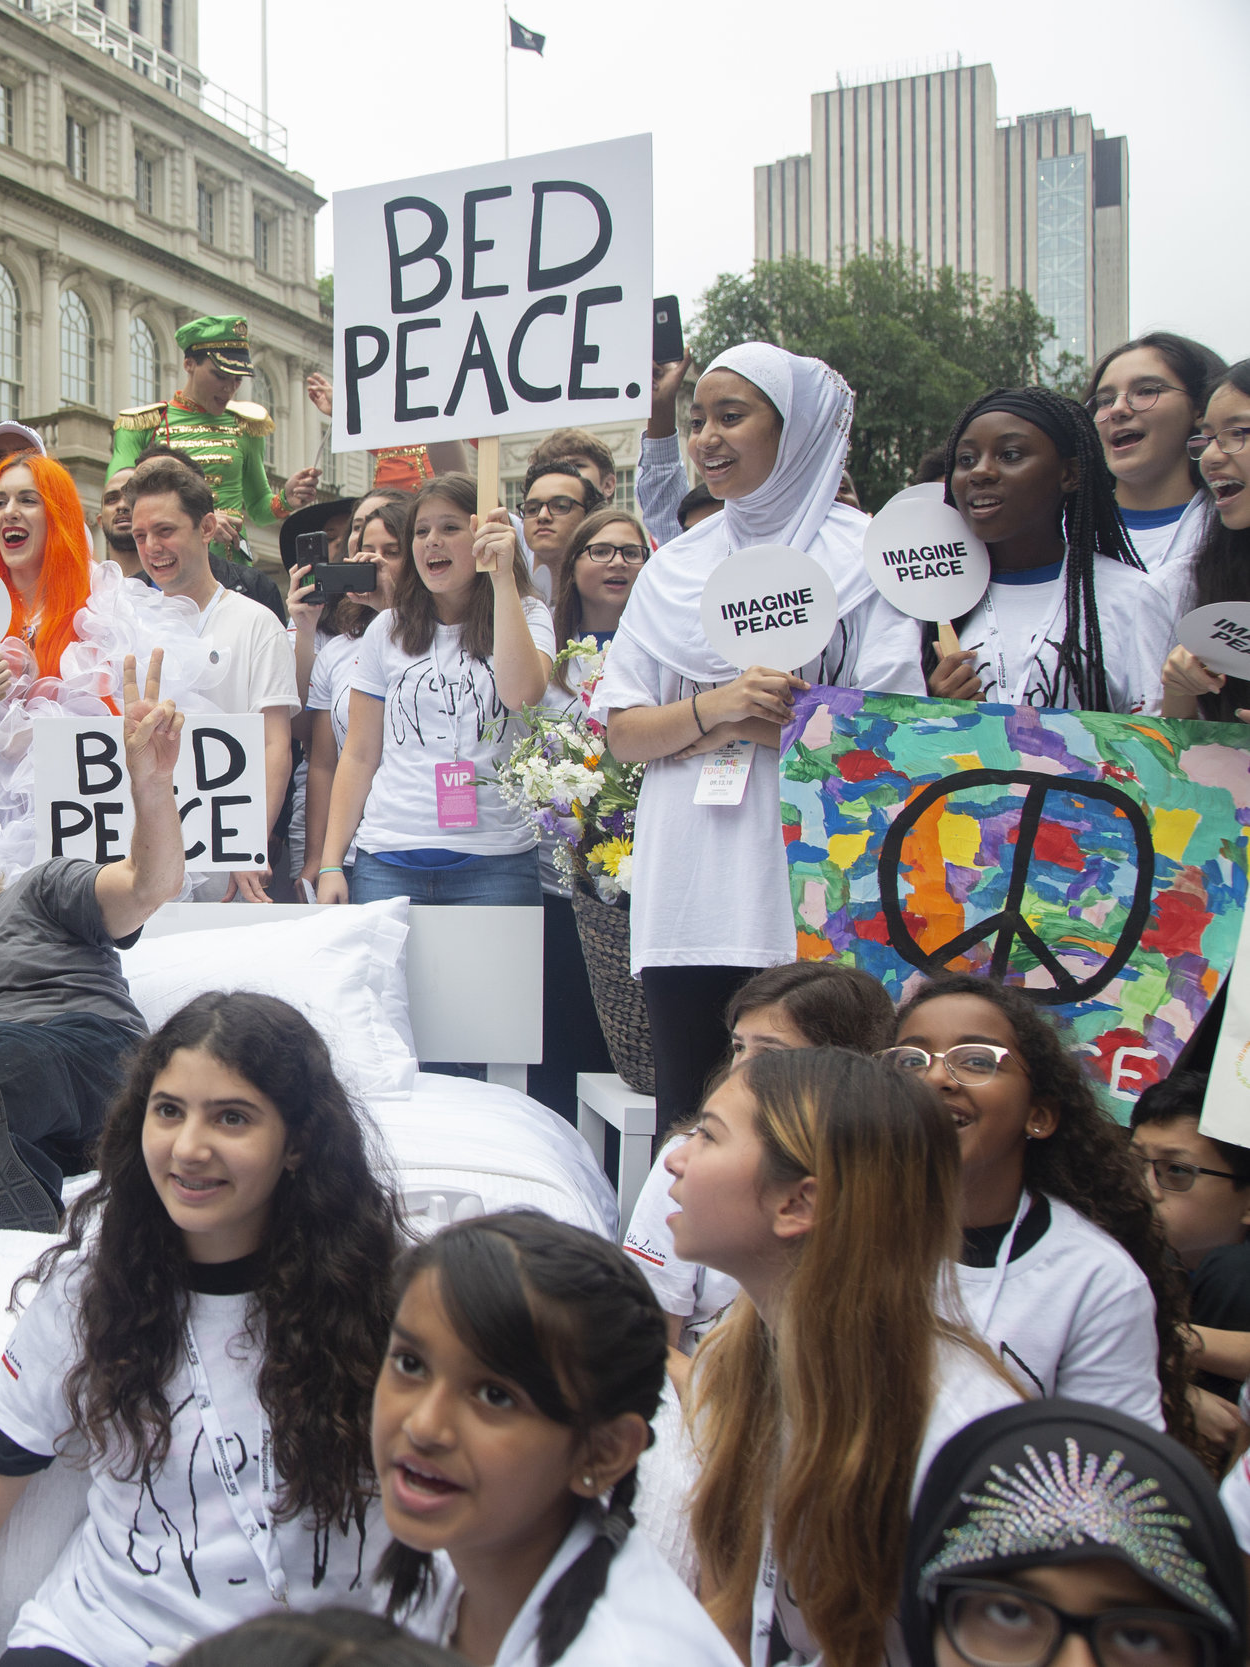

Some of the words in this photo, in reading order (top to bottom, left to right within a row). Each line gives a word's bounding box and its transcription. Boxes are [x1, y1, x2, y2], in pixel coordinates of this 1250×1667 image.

[384, 180, 612, 314] BED
[344, 285, 641, 435] PEACE.
[882, 542, 968, 566] IMAGINE
[896, 560, 964, 582] PEACE
[721, 588, 814, 620] IMAGINE
[734, 608, 808, 636] PEACE
[76, 727, 247, 795] BD
[703, 766, 747, 775] TOGETHER
[714, 758, 739, 767] COME
[442, 772, 470, 787] VIP
[51, 795, 265, 864] PECE.
[215, 1436, 240, 1497] lennonbus.org
